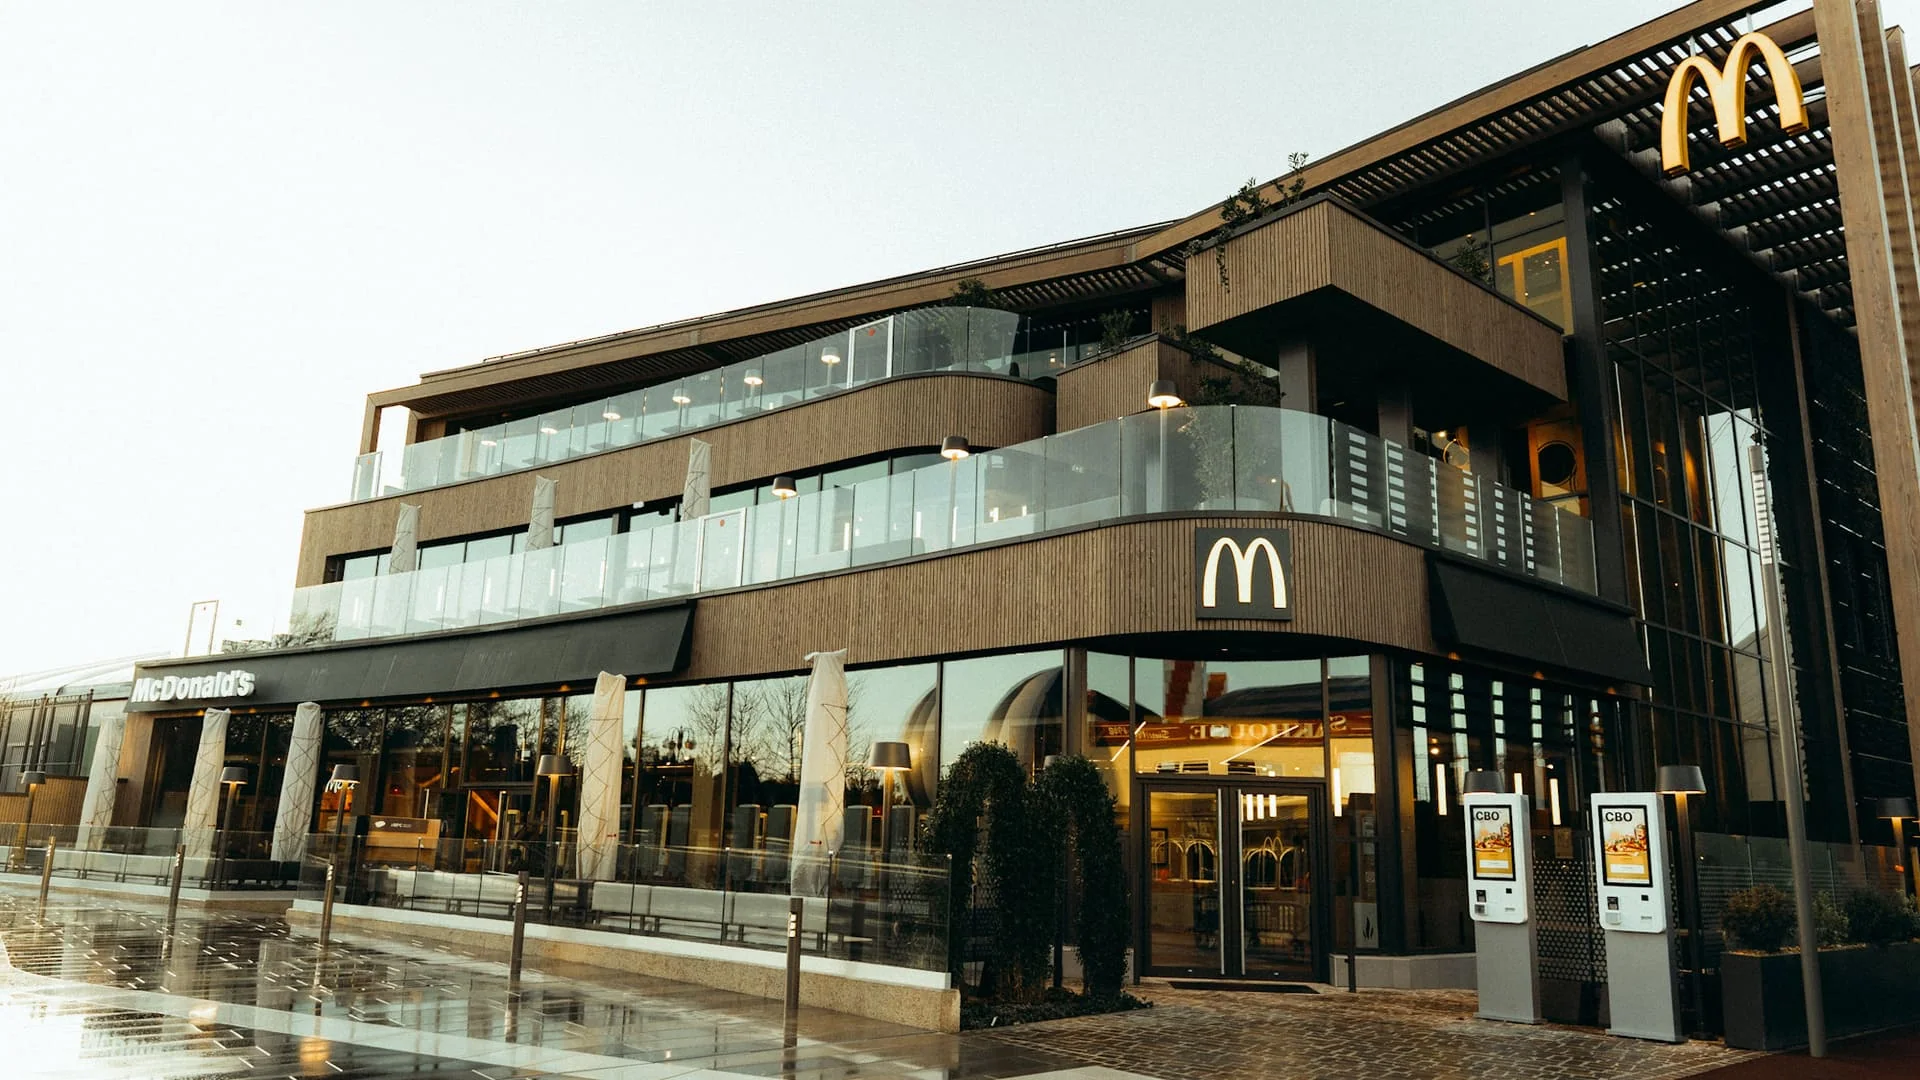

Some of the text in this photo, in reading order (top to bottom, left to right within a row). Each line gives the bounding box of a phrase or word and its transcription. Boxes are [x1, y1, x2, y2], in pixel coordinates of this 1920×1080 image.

[131, 670, 255, 702] McDonald's
[1475, 811, 1500, 821] CBO
[1605, 811, 1633, 822] CBO
